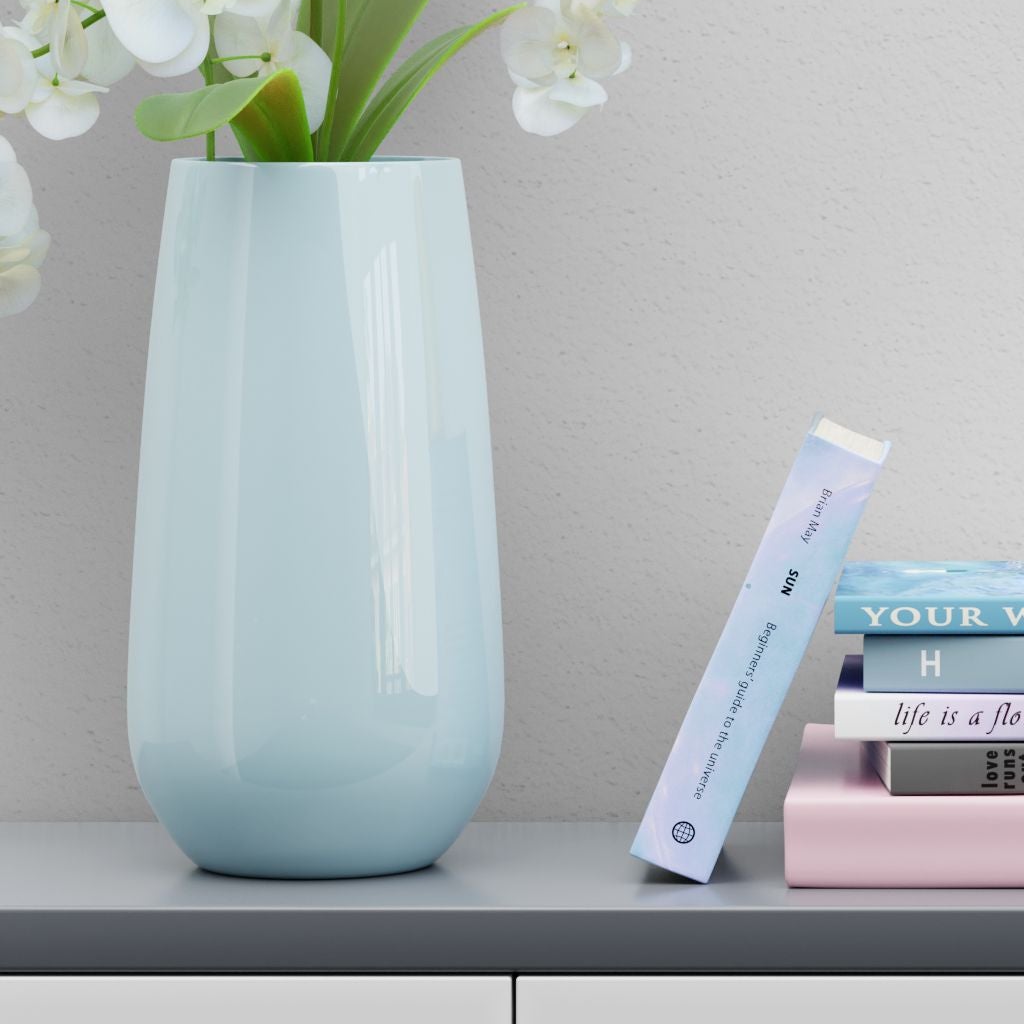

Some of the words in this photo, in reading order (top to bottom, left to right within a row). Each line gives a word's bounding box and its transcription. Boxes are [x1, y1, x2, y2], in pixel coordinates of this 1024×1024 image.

[812, 488, 833, 518] Brian
[800, 520, 820, 544] May
[780, 568, 799, 596] SUN
[860, 606, 989, 628] YOUR
[729, 680, 749, 714] guide
[723, 715, 735, 728] to
[893, 702, 931, 735] life
[940, 706, 959, 726] is
[968, 711, 984, 727] a
[713, 730, 729, 750] the
[693, 751, 719, 800] universe
[981, 750, 999, 788] love
[1003, 749, 1016, 789] runs
